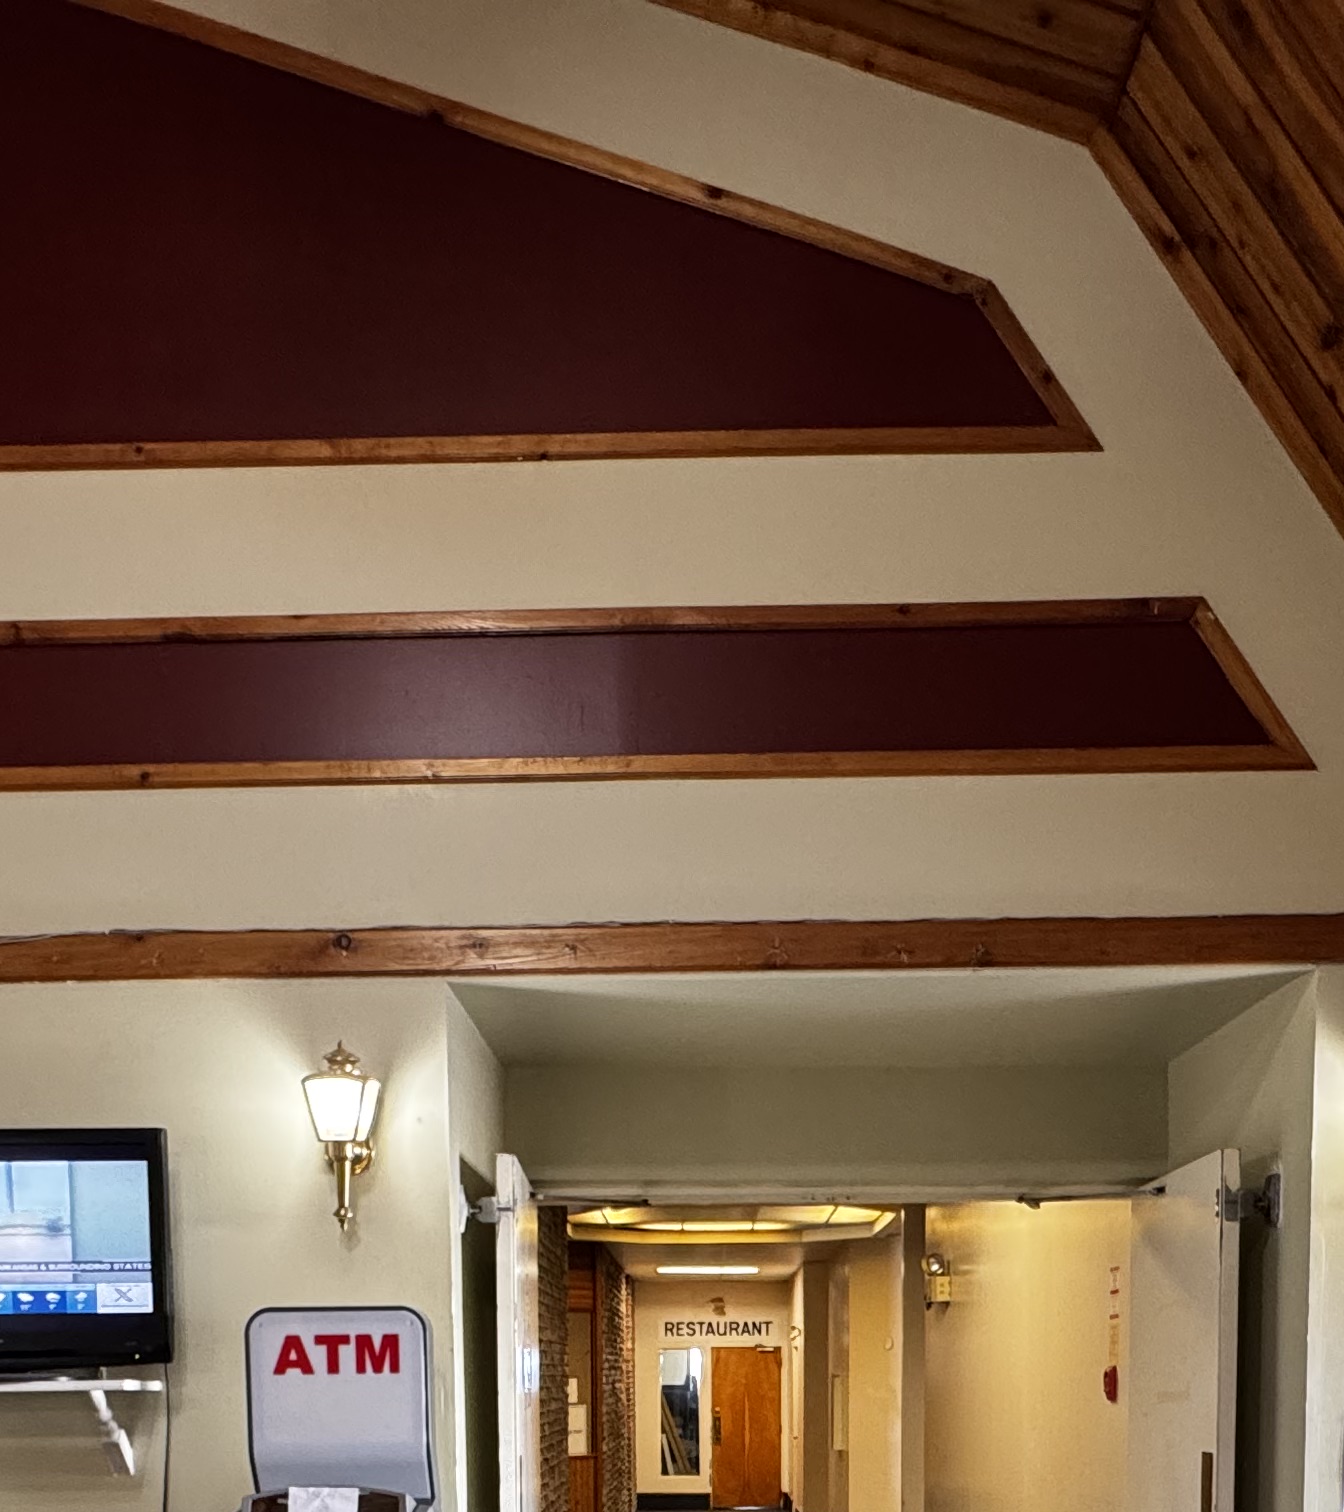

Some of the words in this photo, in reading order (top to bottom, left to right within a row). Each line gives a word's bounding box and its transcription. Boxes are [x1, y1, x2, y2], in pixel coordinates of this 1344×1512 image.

[113, 1262, 151, 1270] STATES
[664, 1321, 774, 1338] RESTAURANT
[273, 1334, 401, 1376] ATM
